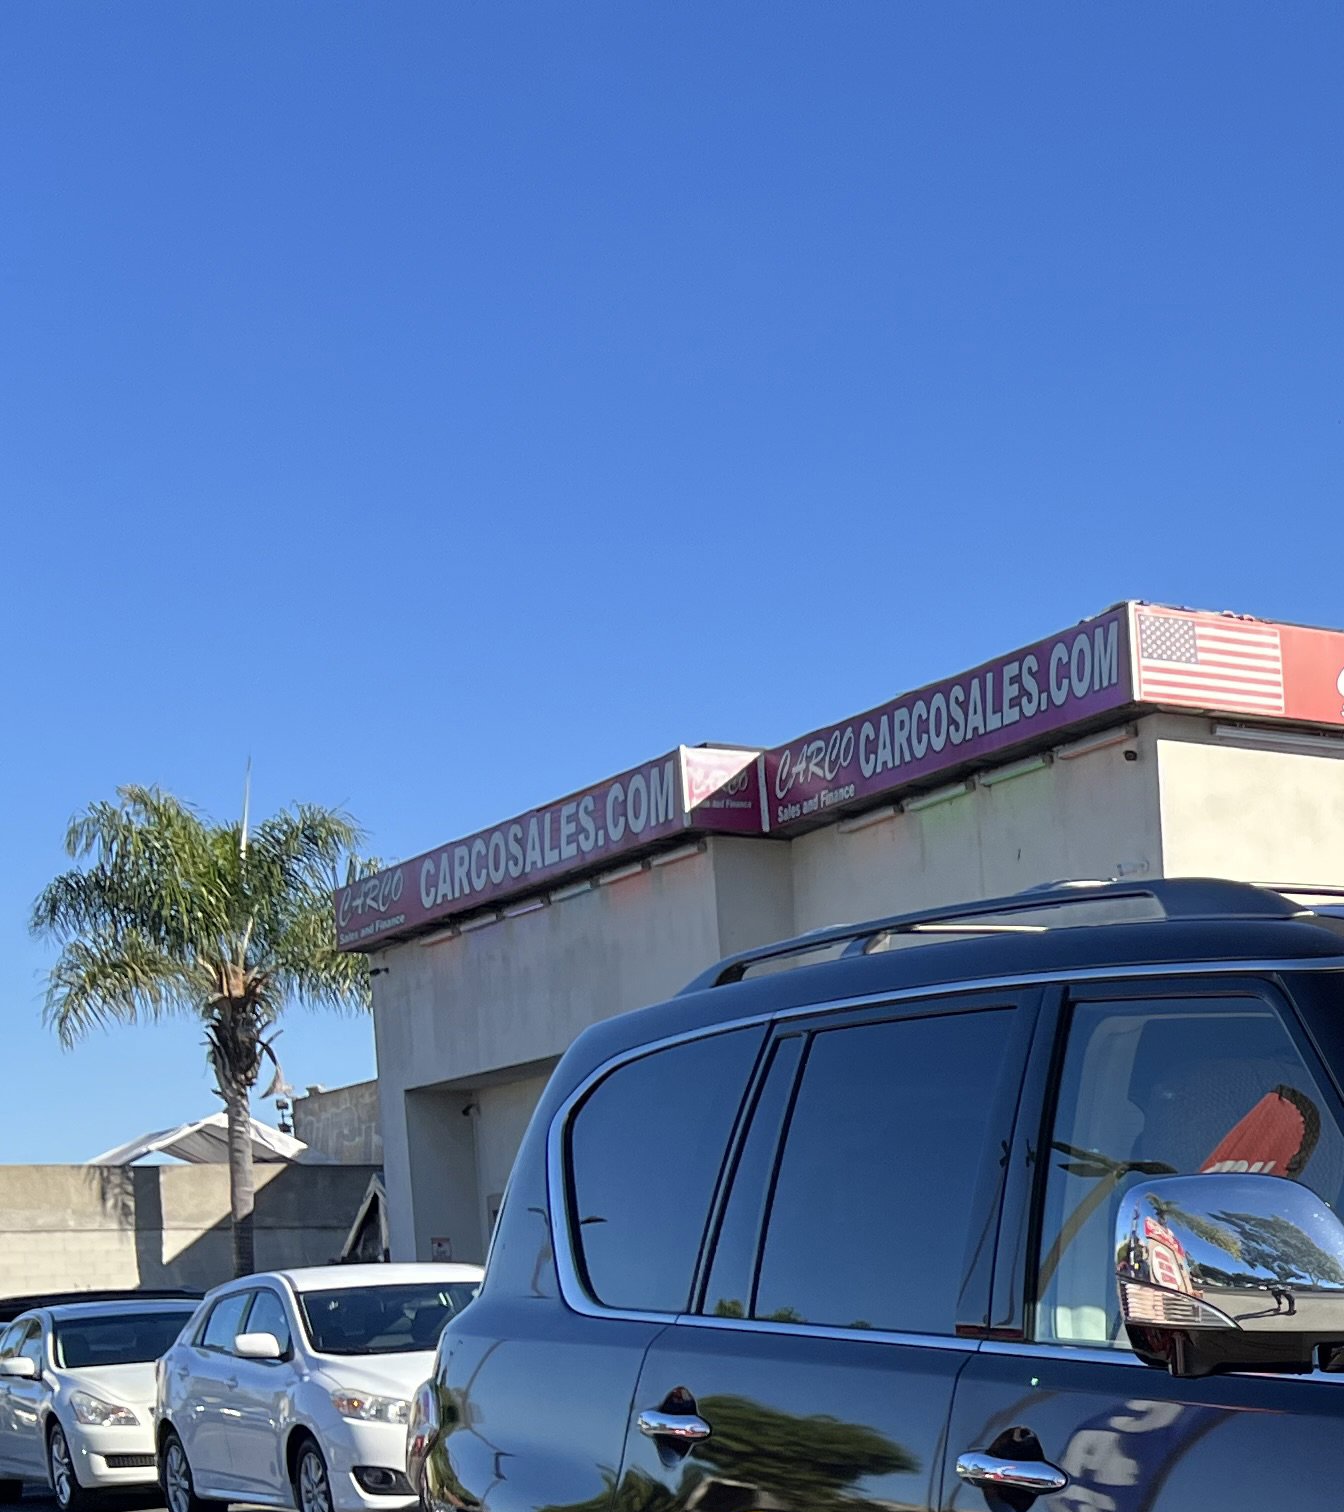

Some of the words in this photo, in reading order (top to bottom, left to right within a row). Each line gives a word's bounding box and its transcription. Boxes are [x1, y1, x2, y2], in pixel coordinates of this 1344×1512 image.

[859, 620, 1120, 779] CARCOSALES.COM
[775, 727, 855, 799] CARCO
[419, 760, 675, 910] CARCOSALES.COM
[778, 801, 801, 824] Sales
[803, 795, 818, 815] and
[820, 783, 856, 806] Finance
[339, 867, 405, 928] CARCO
[374, 913, 406, 936] Finance
